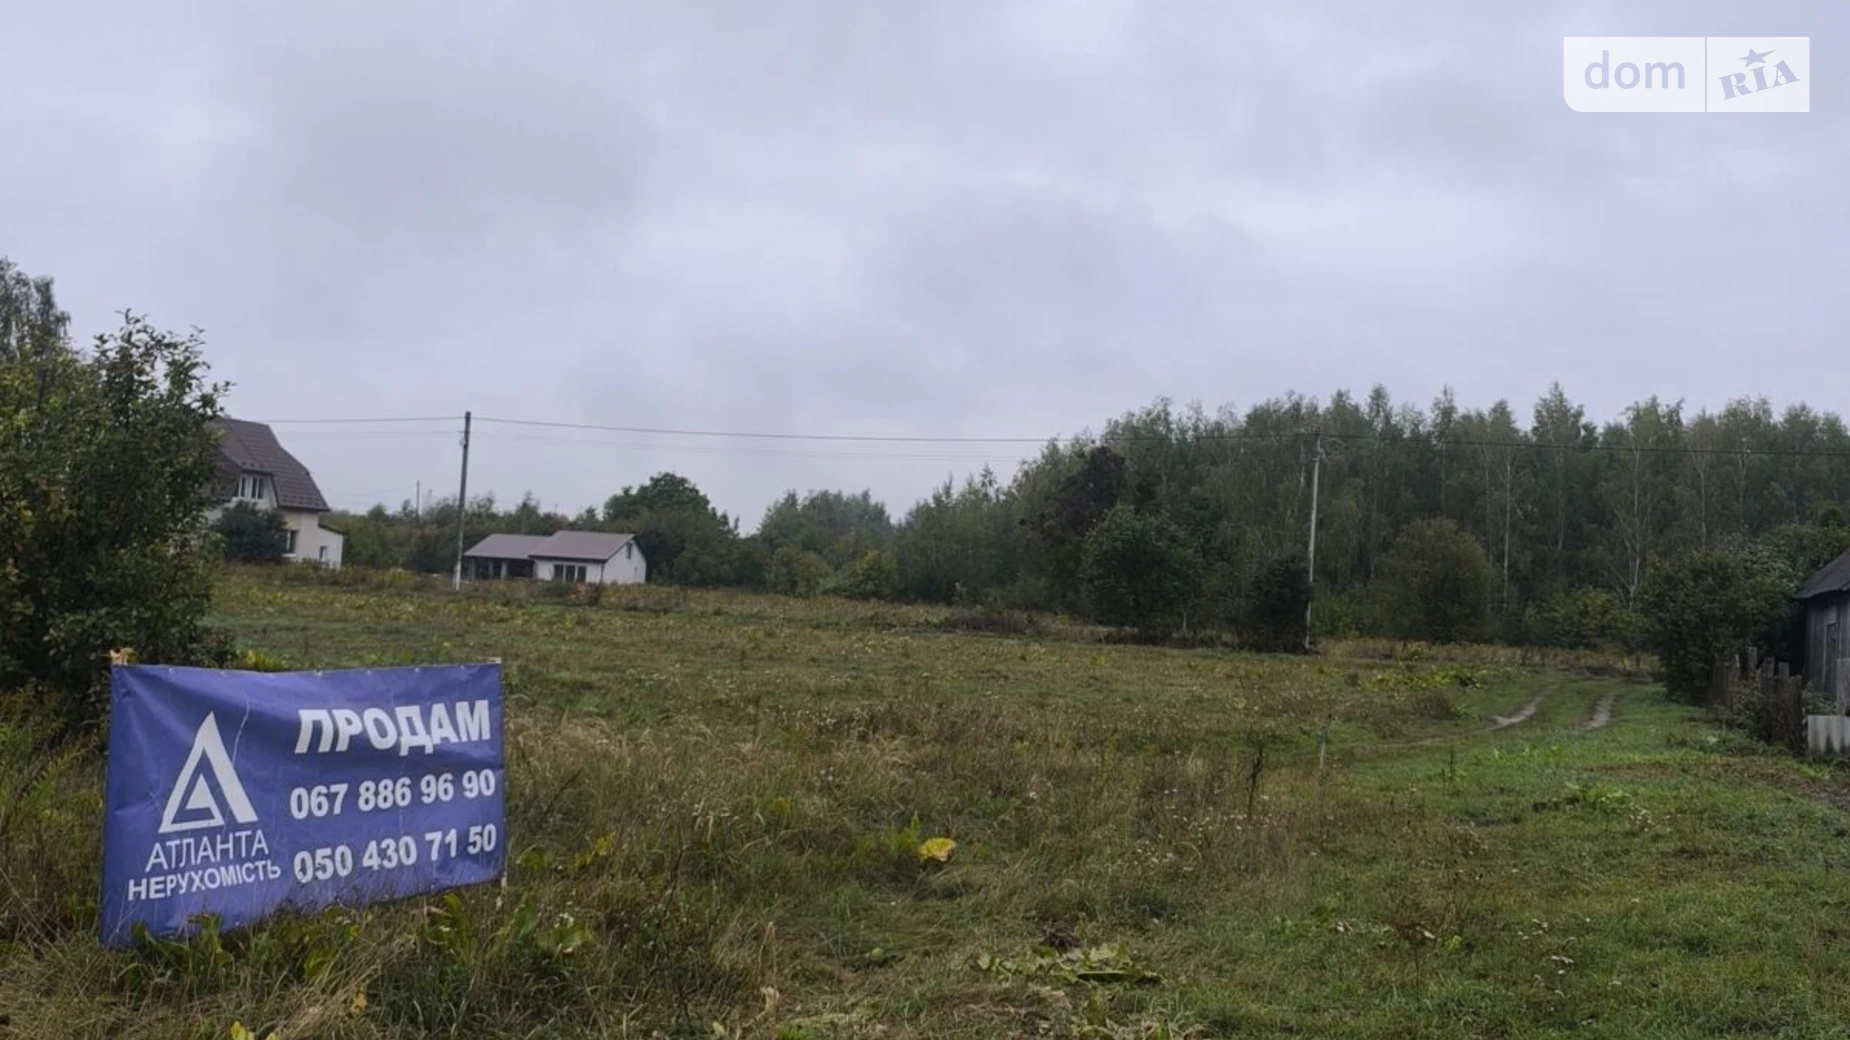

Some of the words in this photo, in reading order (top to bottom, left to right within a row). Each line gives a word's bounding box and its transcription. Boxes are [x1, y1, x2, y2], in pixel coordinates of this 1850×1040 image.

[294, 700, 492, 757] ПРОДАМ
[290, 783, 349, 820] 067
[357, 777, 413, 812] 886
[420, 772, 455, 804] 96
[462, 768, 497, 799] 90
[145, 829, 270, 873] АТЛАНТА
[293, 844, 354, 884] 050
[361, 835, 418, 871] 430
[425, 828, 458, 862] 71
[467, 823, 498, 855] 50
[127, 859, 282, 902] НЕРУХОМІСТЬ
